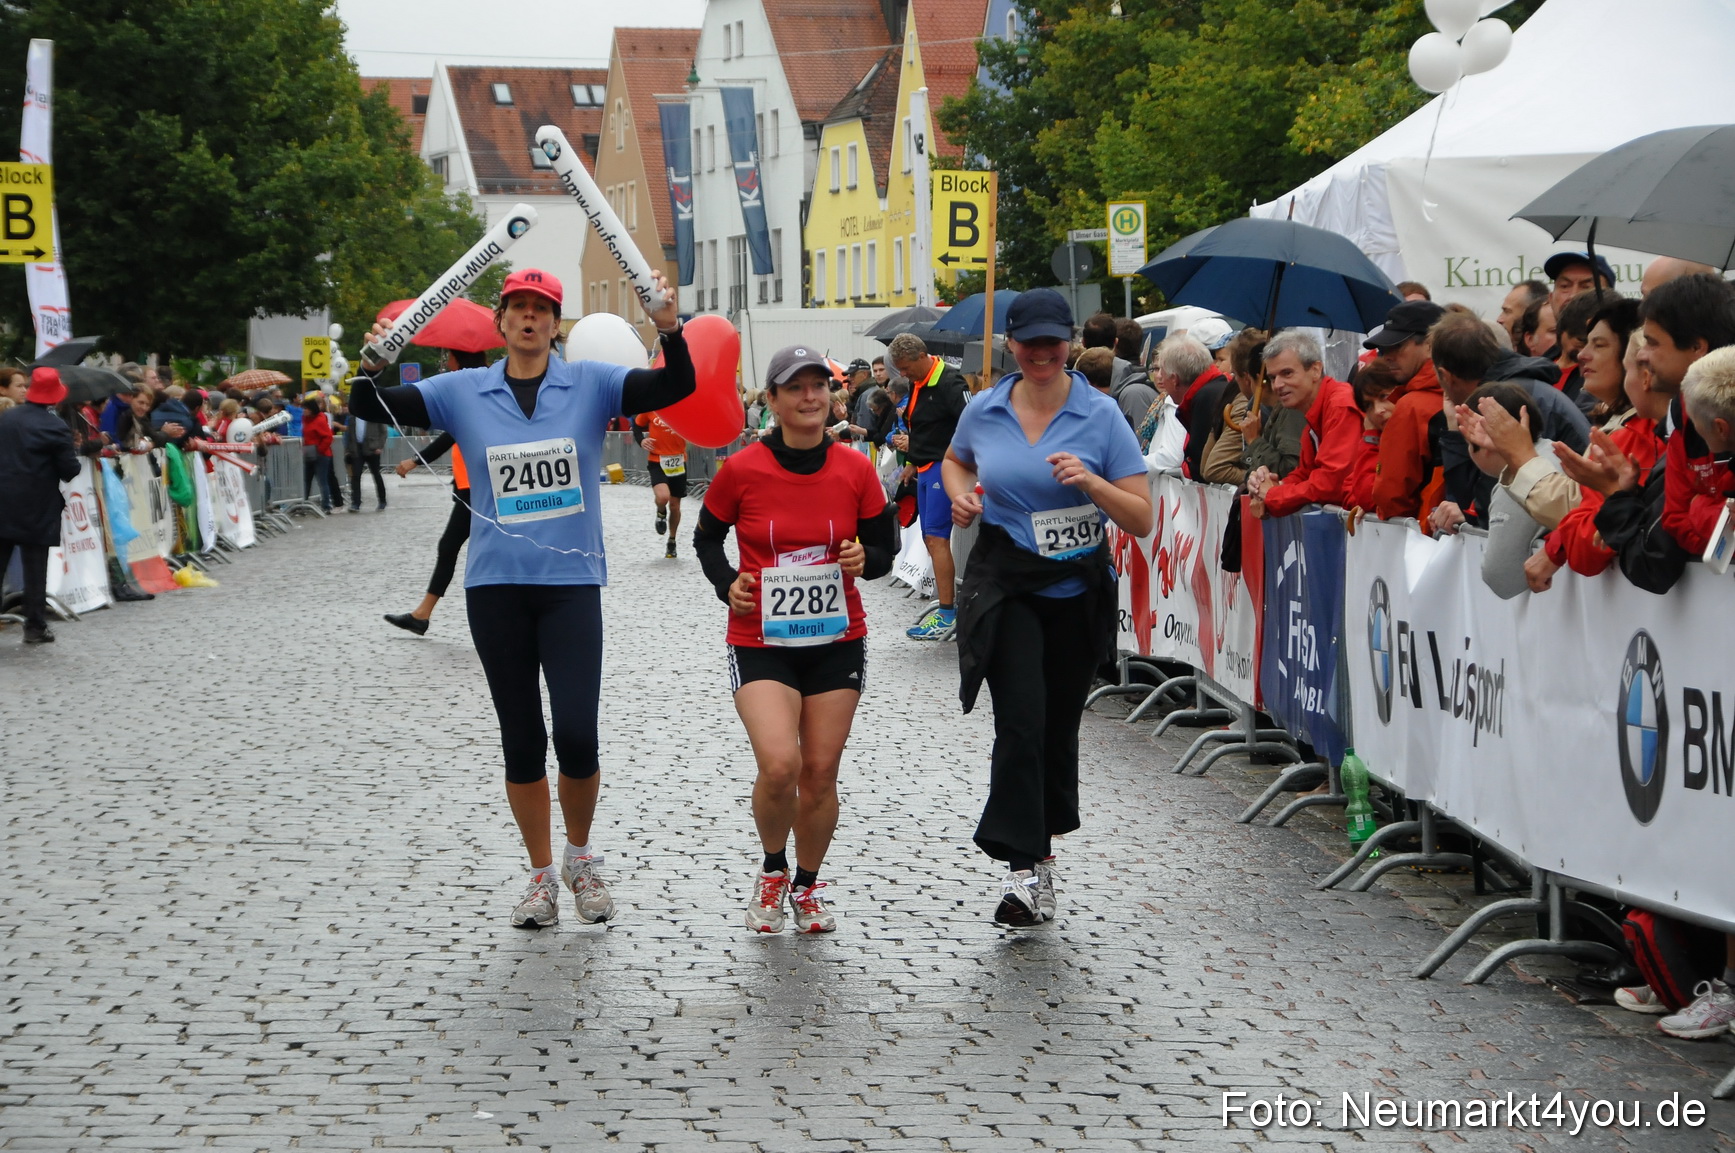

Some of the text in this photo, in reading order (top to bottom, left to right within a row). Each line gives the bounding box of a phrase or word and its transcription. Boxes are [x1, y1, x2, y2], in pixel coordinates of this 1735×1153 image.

[941, 175, 990, 193] Block
[3, 193, 36, 240] B
[949, 200, 979, 247] B
[1120, 213, 1134, 229] H
[841, 216, 859, 238] HOTEL
[1444, 255, 1554, 288] Kinde
[383, 241, 504, 352] bmw-laufsport.de
[304, 338, 327, 346] Block
[308, 349, 323, 369] C
[489, 447, 560, 462] PARTL Neumarkt
[665, 458, 680, 467] 422
[500, 458, 571, 493] 2409
[516, 495, 563, 512] Cornelia
[1034, 517, 1062, 527] PARTL
[1045, 520, 1101, 551] 2397
[792, 552, 813, 563] DEHN
[763, 573, 831, 583] PARTL Neumarkt
[771, 584, 839, 616] 2282
[789, 622, 825, 636] Margit
